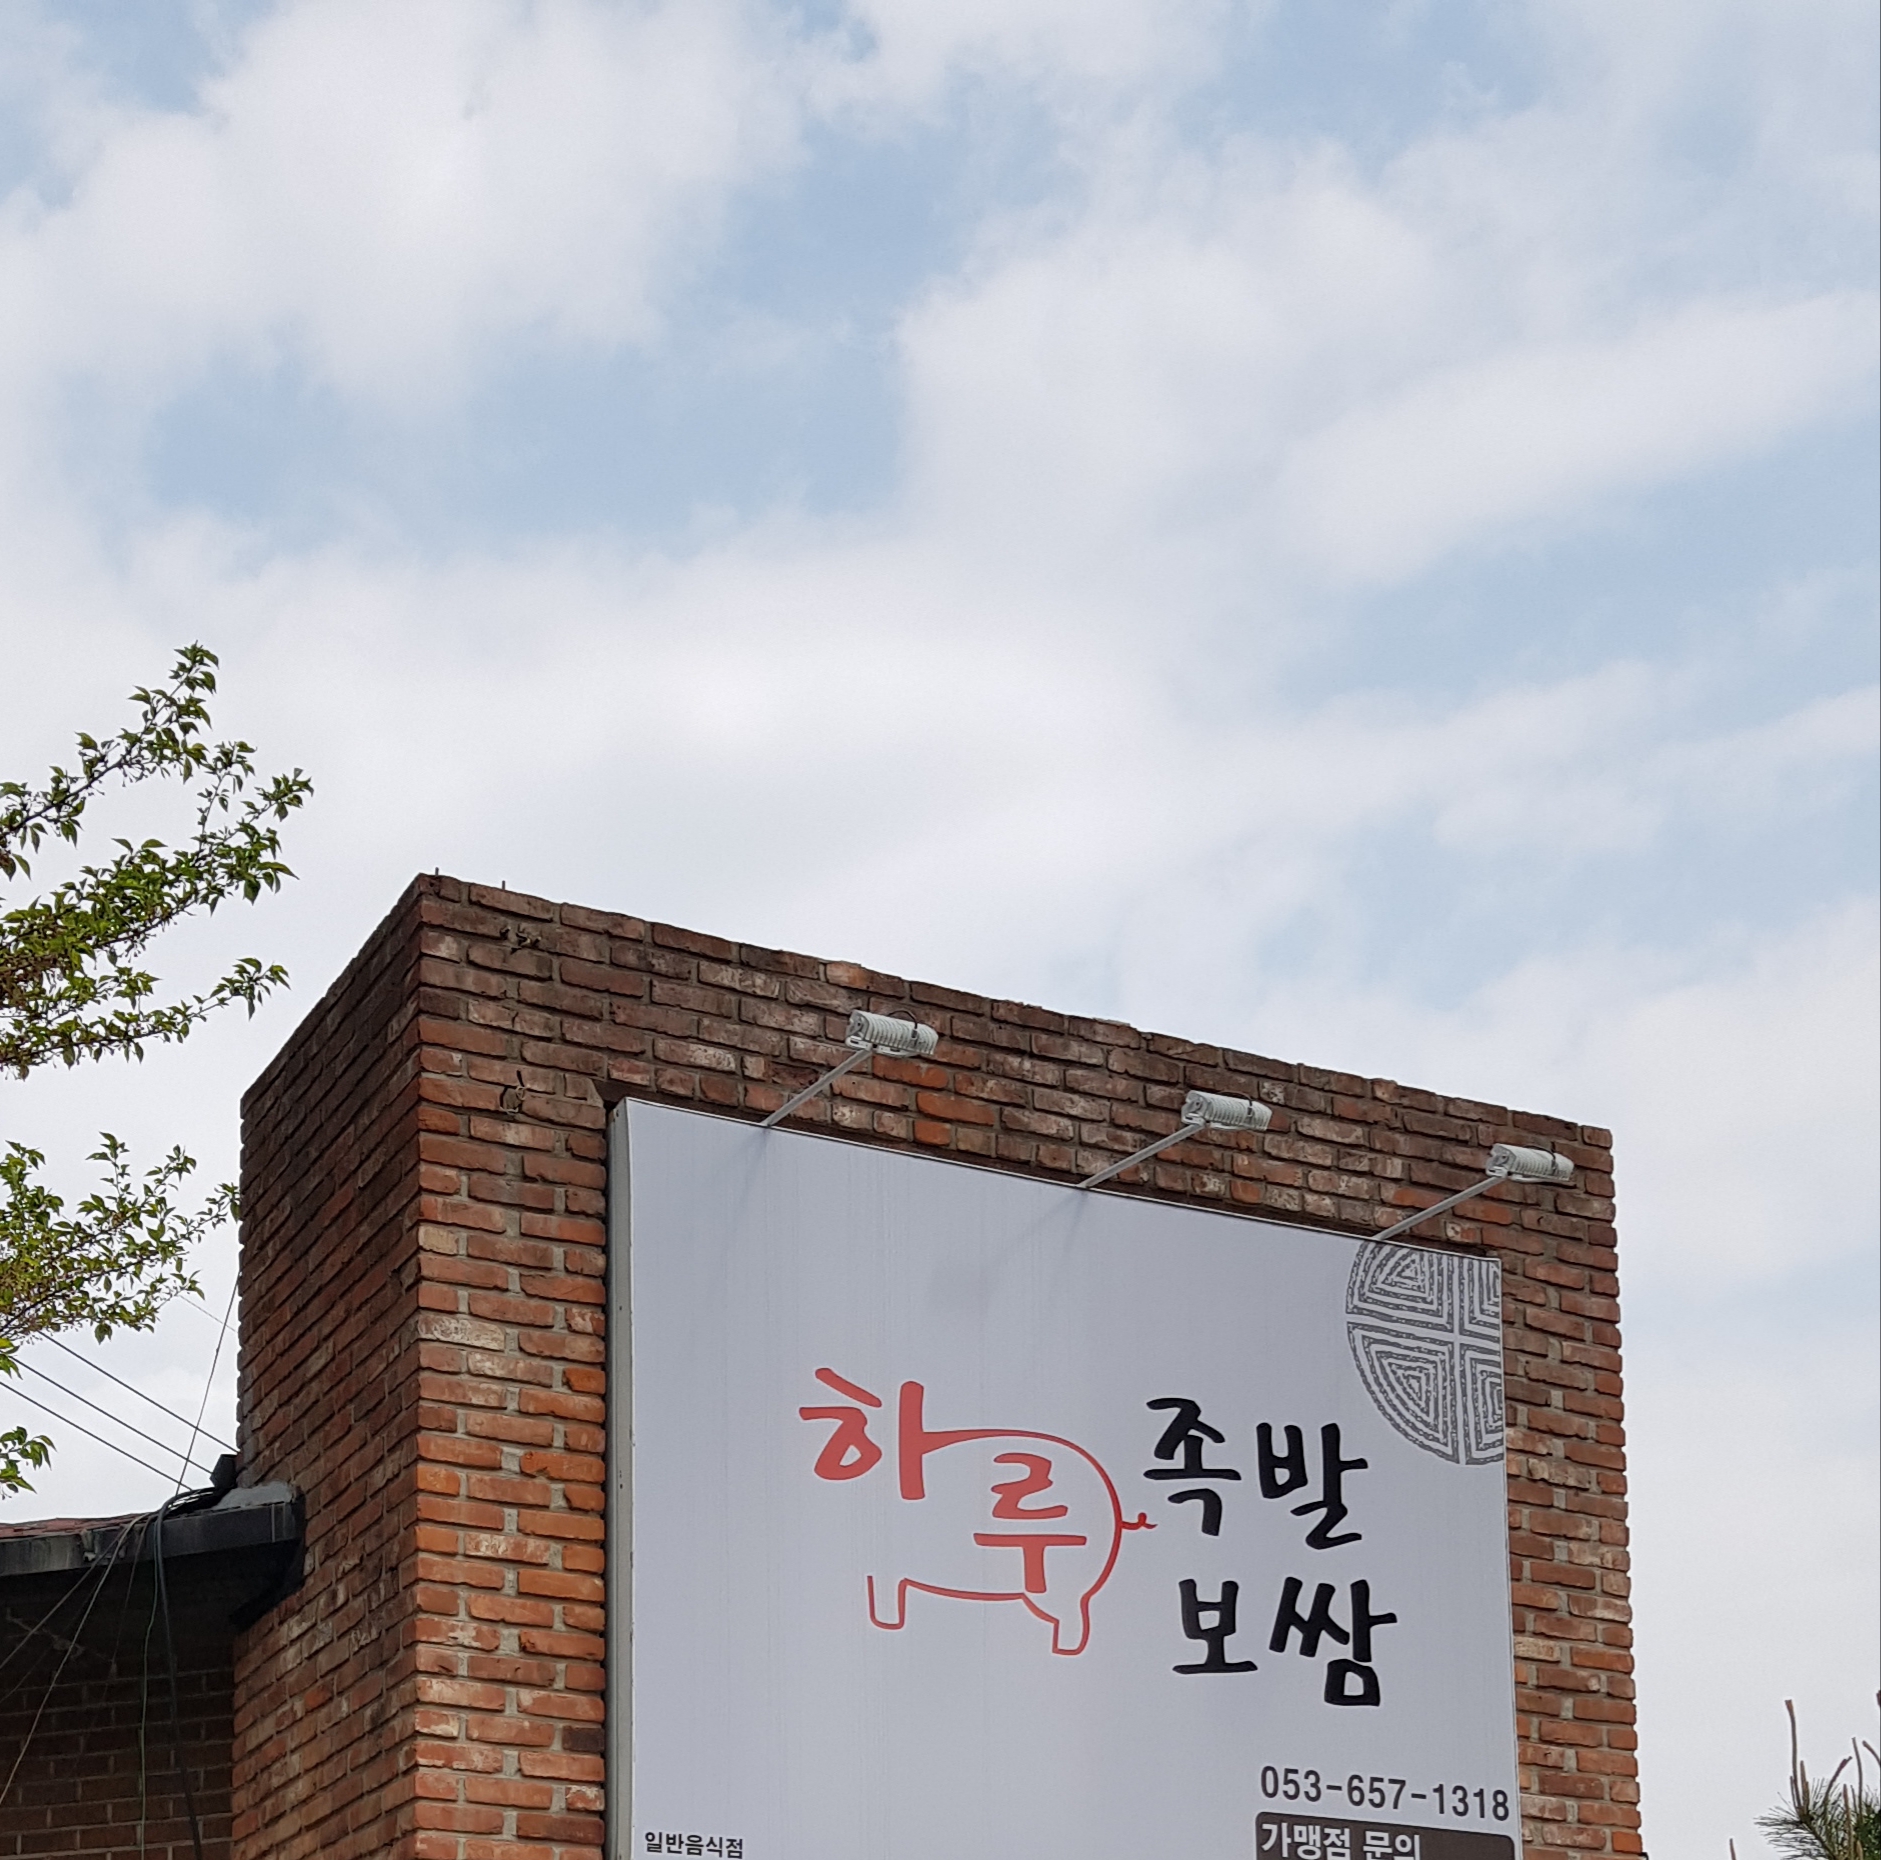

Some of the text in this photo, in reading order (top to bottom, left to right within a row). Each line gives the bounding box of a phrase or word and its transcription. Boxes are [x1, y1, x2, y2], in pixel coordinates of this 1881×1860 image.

[799, 1367, 1368, 1594] 하루 족발
[1172, 1576, 1398, 1707] 보쌈
[1260, 1765, 1510, 1822] 053-657-1318
[644, 1831, 744, 1860] 일반음식점
